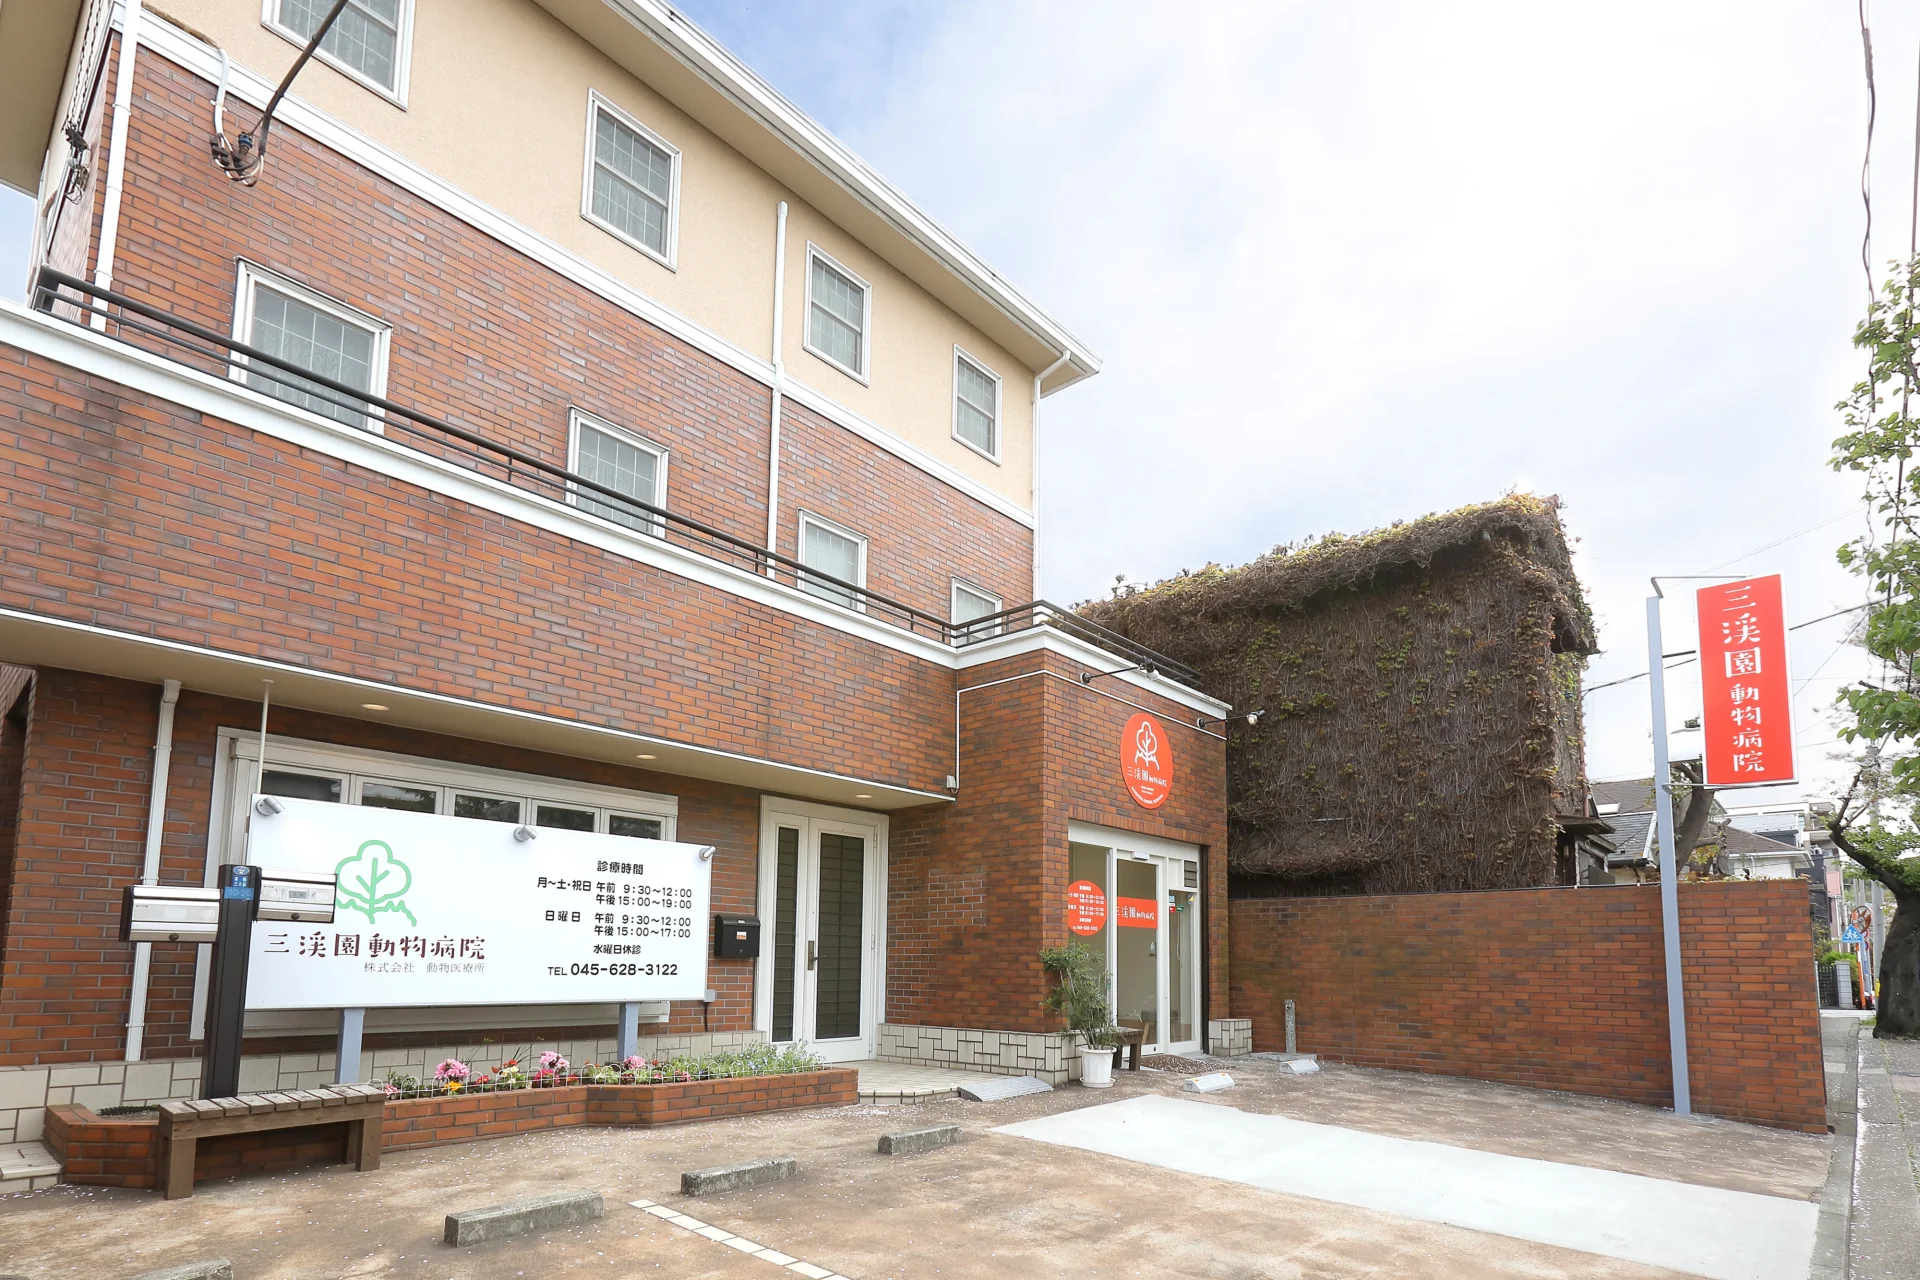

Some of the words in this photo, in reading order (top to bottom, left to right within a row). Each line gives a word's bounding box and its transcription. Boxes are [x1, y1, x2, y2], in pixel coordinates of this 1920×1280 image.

[597, 860, 644, 875] 診療時間
[596, 881, 616, 894] 午前
[595, 893, 616, 906] 午後
[545, 910, 581, 923] 日曜日
[594, 912, 615, 924] 午前
[594, 925, 614, 937] 午後
[593, 943, 642, 955] 水曜日休診
[363, 961, 415, 973] 株式会社
[426, 962, 485, 973] 動物医療所
[547, 966, 568, 976] TEL
[570, 963, 678, 976] 045-628-3122
